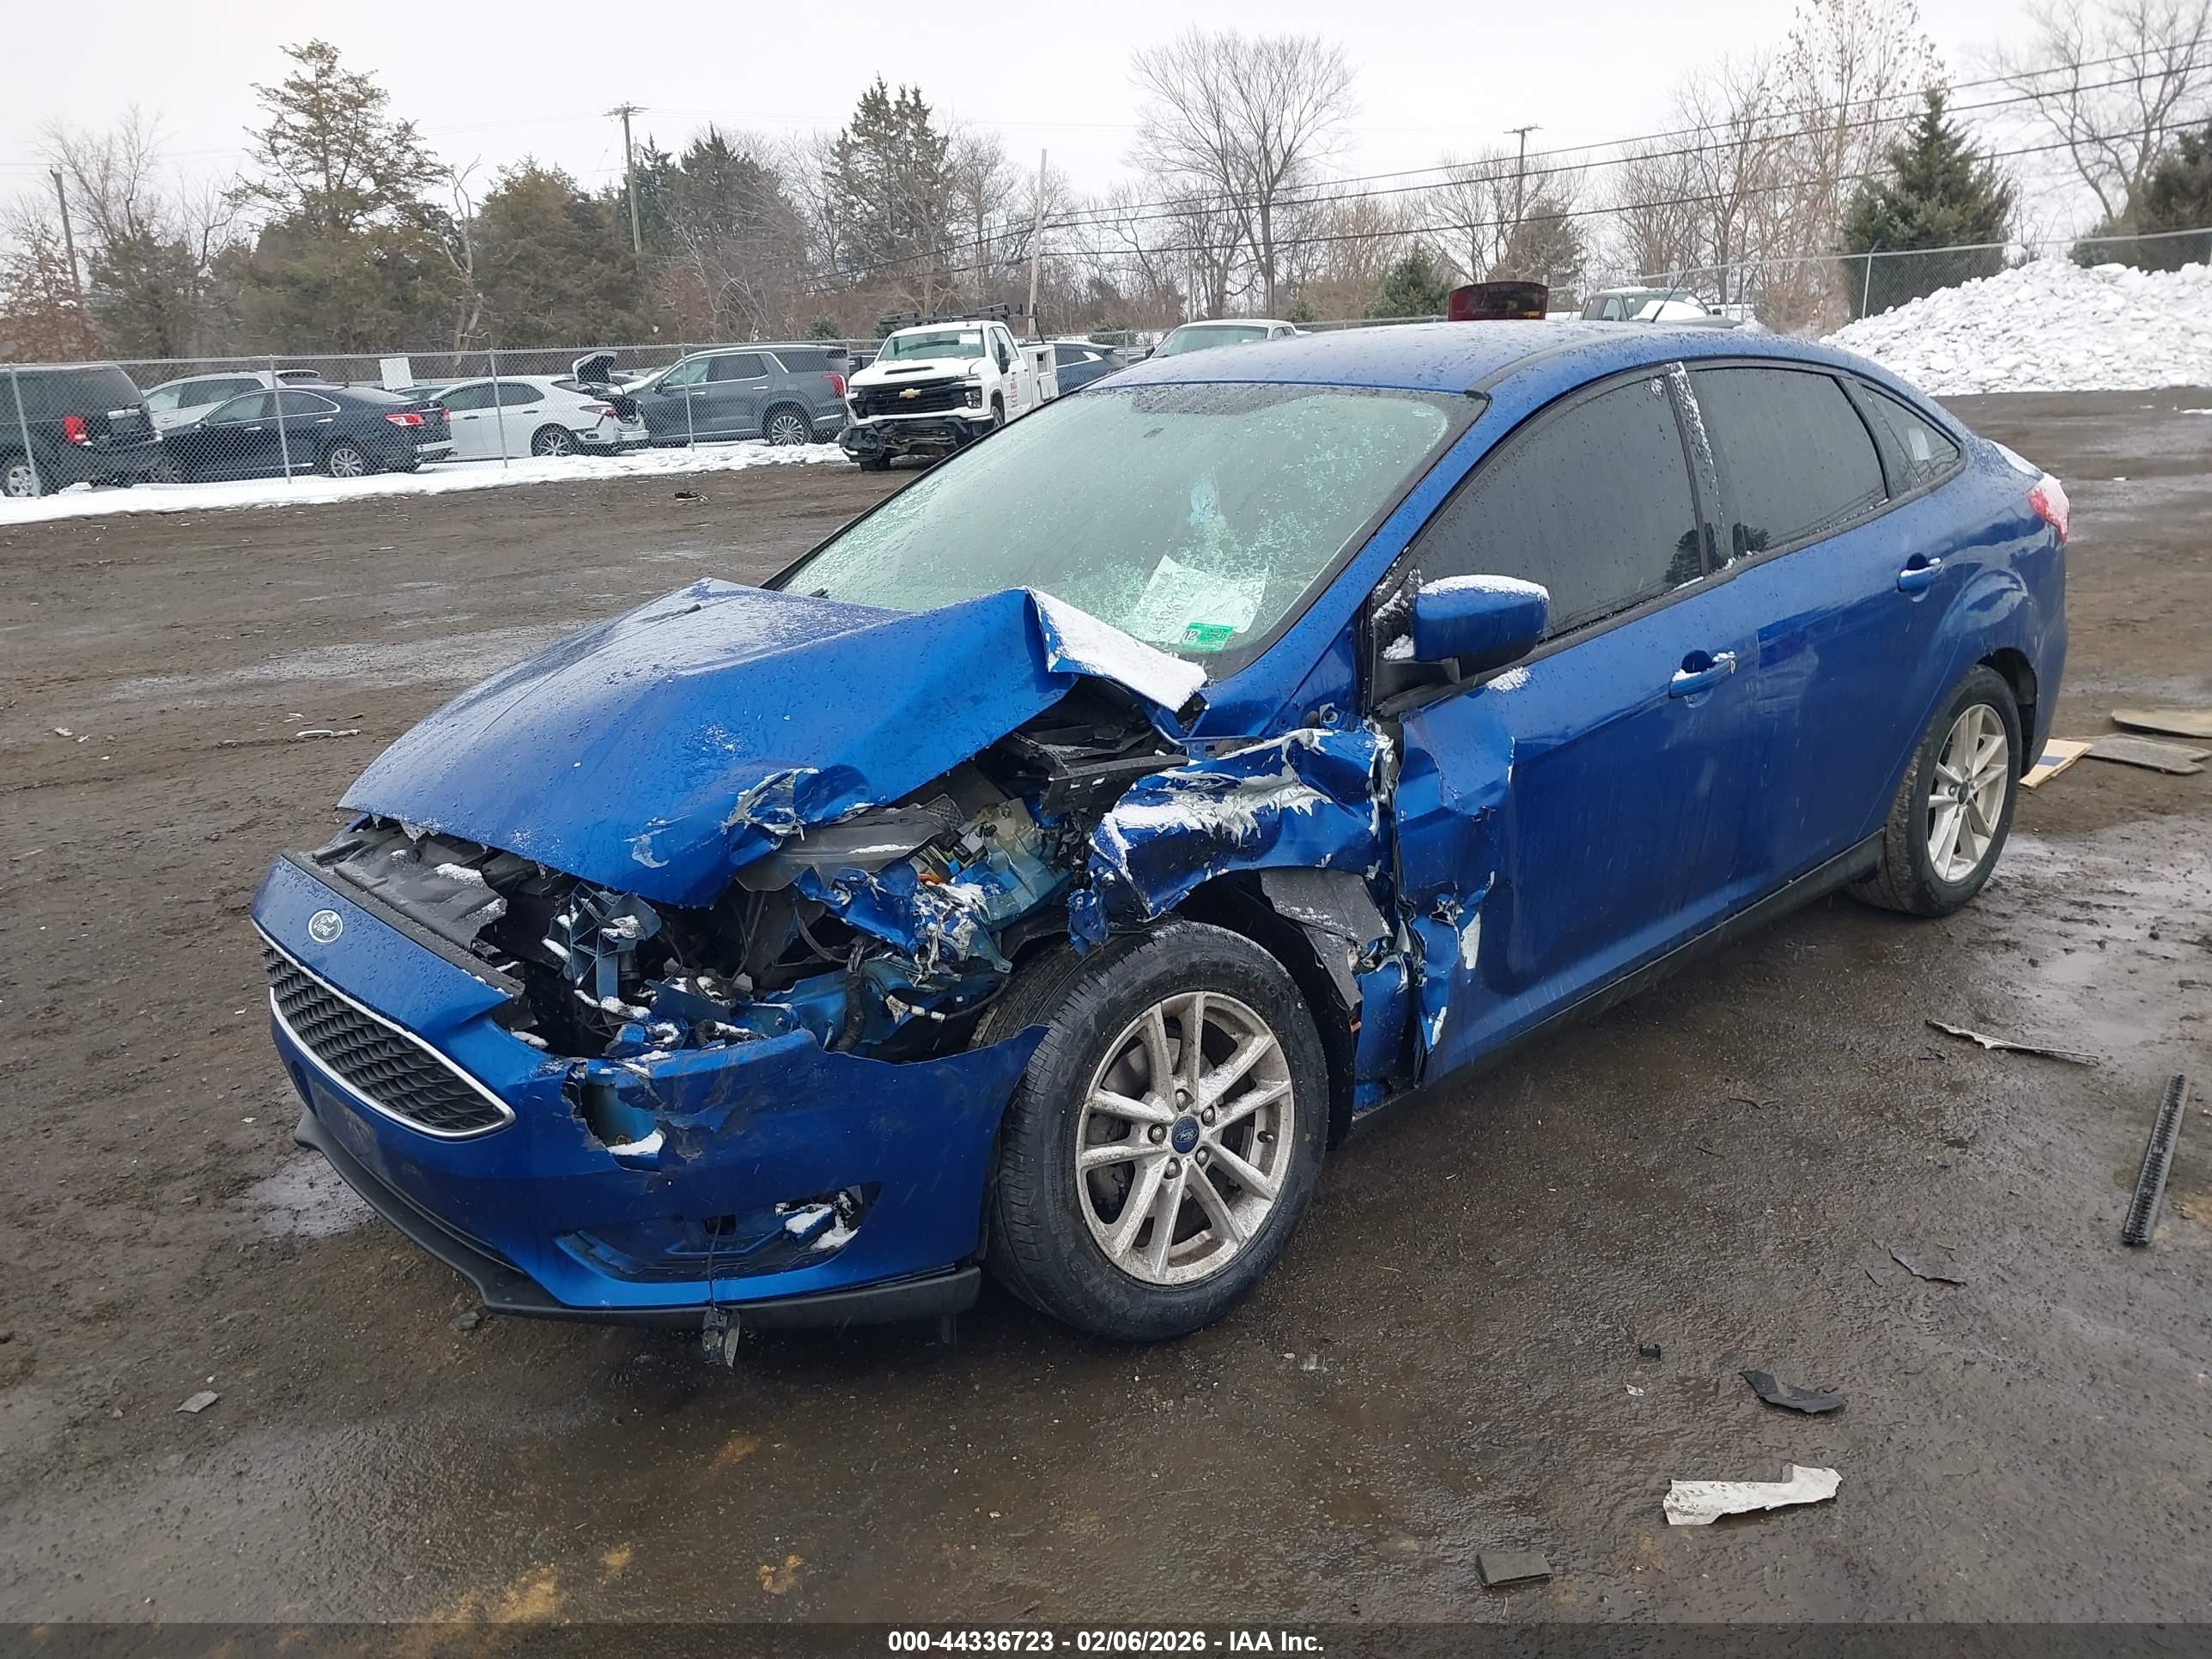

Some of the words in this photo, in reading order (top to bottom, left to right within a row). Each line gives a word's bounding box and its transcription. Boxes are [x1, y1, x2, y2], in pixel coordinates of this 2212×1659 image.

[1182, 629, 1199, 641] 12
[313, 915, 336, 937] Ford
[1179, 1129, 1194, 1141] Ford
